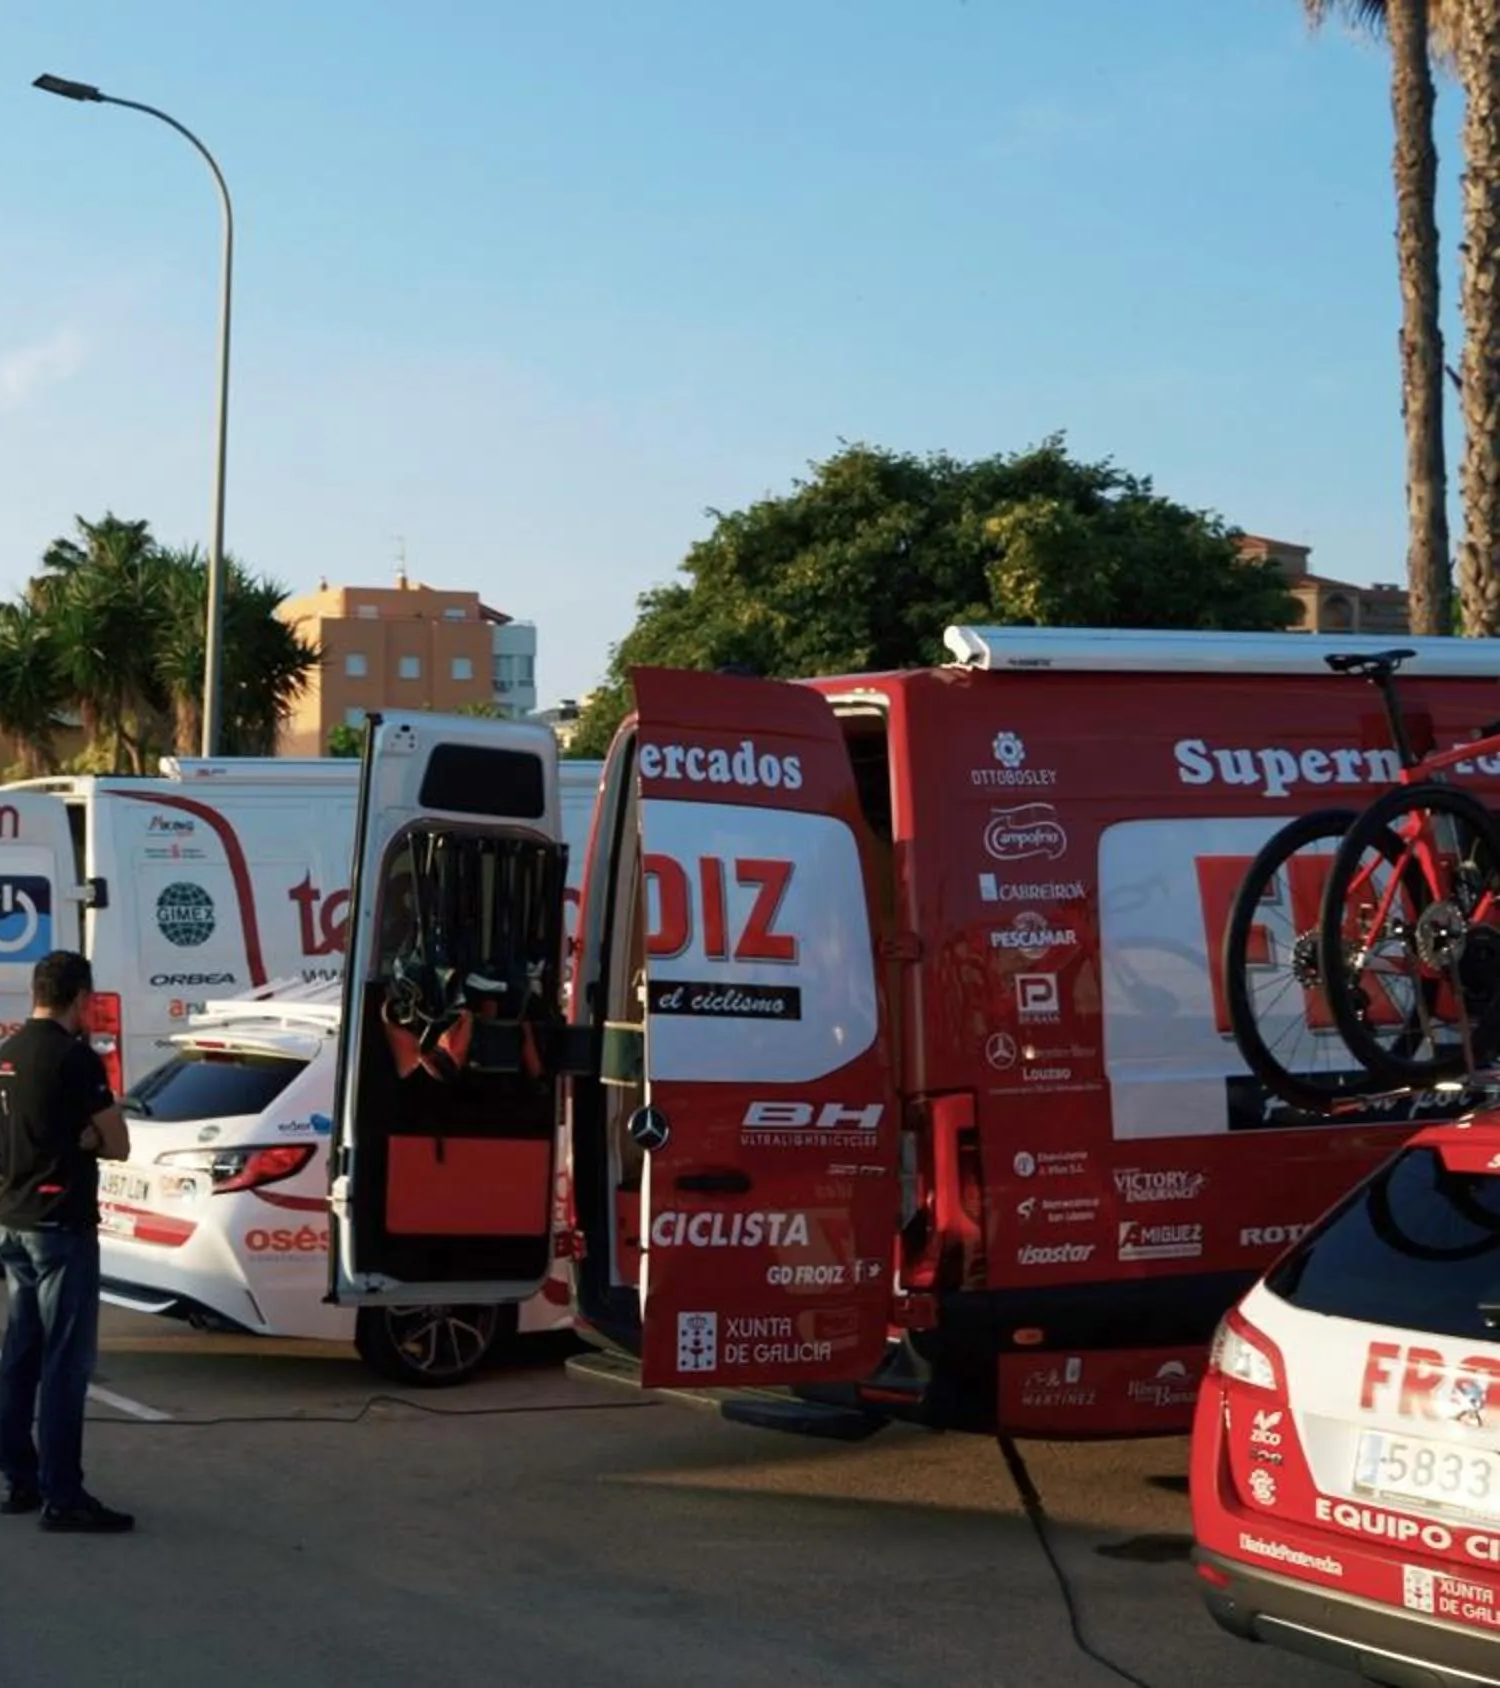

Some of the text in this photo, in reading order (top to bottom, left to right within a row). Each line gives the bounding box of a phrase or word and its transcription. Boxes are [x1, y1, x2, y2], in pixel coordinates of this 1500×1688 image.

[639, 741, 803, 789] ercados
[157, 904, 216, 923] GIMEX
[991, 929, 1077, 948] PESCAMAR
[150, 973, 236, 987] ORBEA
[658, 986, 786, 1014] el ciclismo
[741, 1101, 885, 1127] BH
[1113, 1171, 1189, 1192] VICTORY
[651, 1211, 810, 1247] CICLISTA
[1240, 1224, 1311, 1245] ROT
[766, 1265, 792, 1285] GD
[795, 1264, 844, 1285] FROIZ
[724, 1317, 792, 1339] XUNTA
[724, 1342, 832, 1364] DE GALICIA
[1388, 1443, 1492, 1499] 5833
[1315, 1498, 1453, 1550] EQUIPO
[1440, 1579, 1494, 1604] XUNTA
[1439, 1597, 1460, 1615] DE
